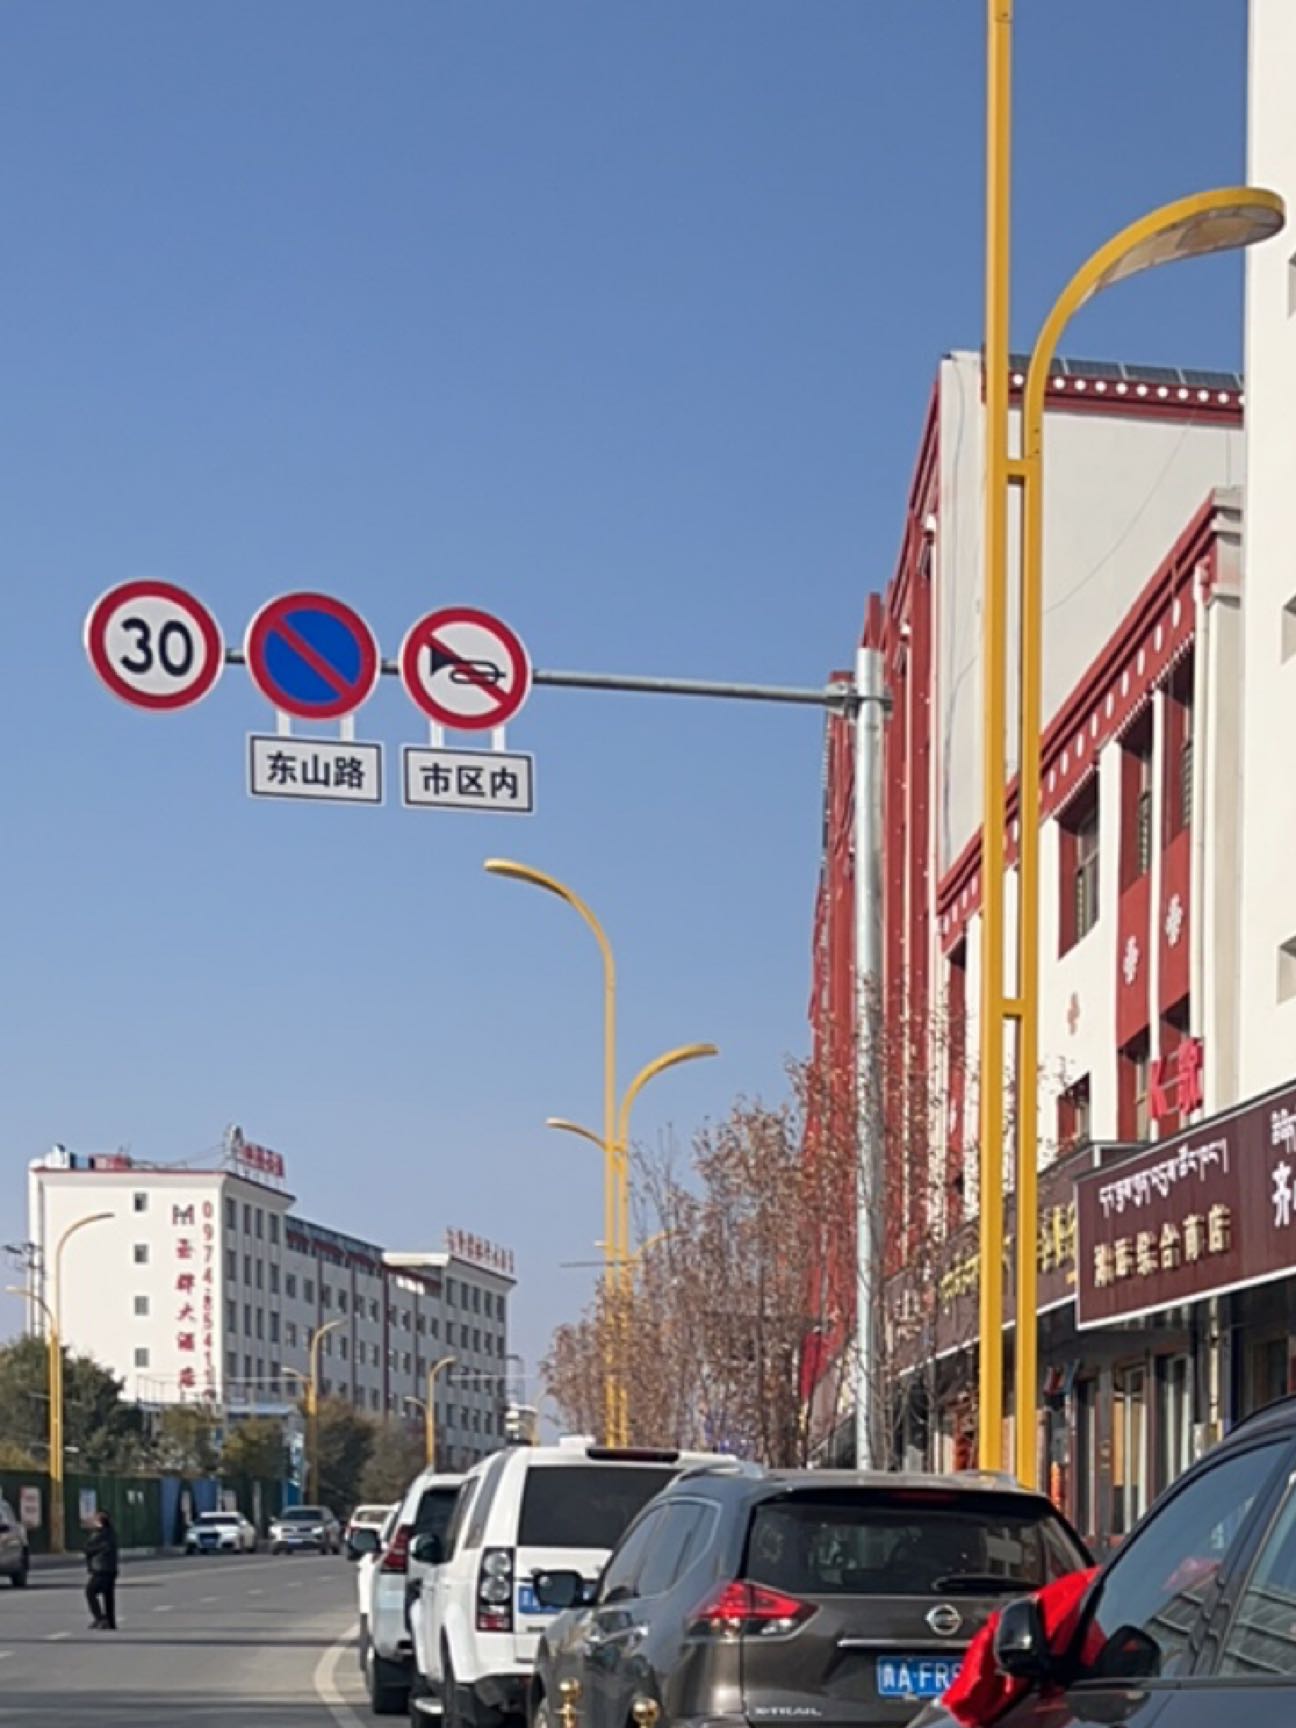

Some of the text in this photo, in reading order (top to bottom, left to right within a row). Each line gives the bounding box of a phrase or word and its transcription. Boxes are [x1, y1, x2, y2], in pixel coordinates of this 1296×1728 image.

[120, 617, 194, 677] 30
[266, 751, 365, 790] 东山路
[420, 763, 518, 799] 市区内
